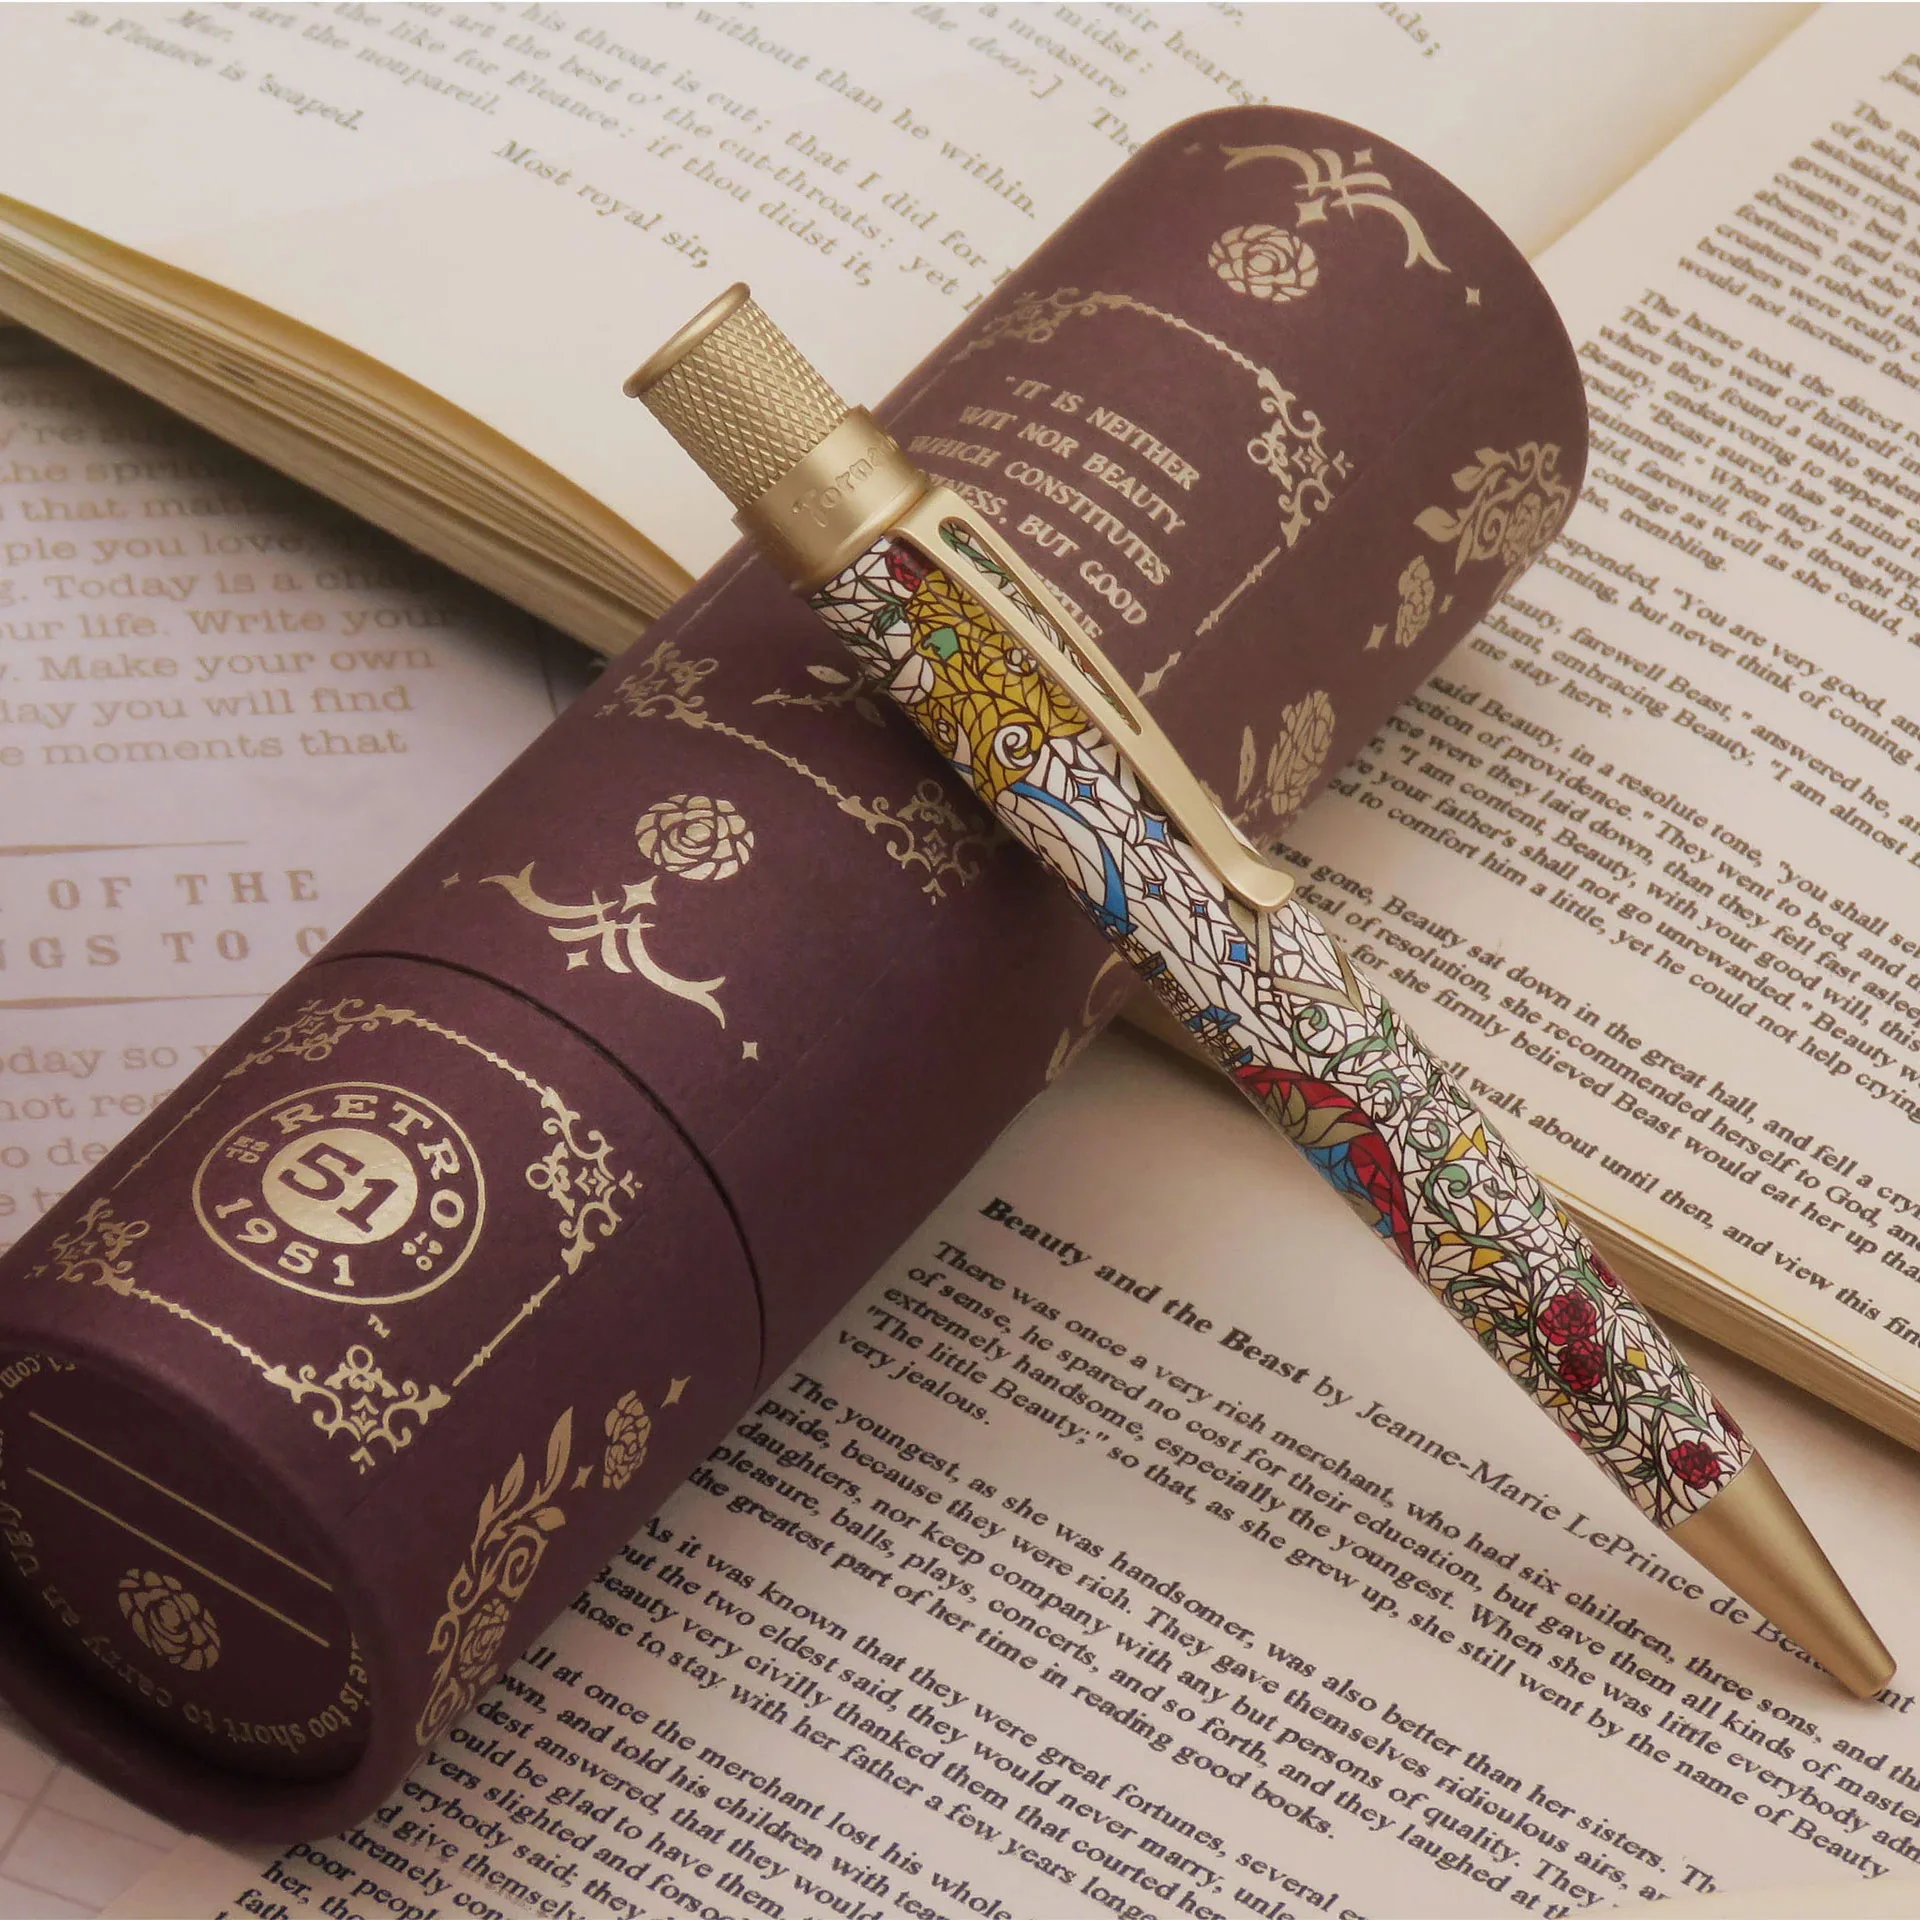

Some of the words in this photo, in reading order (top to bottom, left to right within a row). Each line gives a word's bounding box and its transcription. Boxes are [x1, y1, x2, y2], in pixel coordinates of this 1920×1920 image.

[573, 26, 668, 76] throat
[670, 68, 701, 93] is
[783, 129, 851, 175] that
[880, 191, 939, 232] did
[937, 229, 988, 269] for
[694, 9, 810, 71] without
[814, 67, 884, 114] than
[890, 106, 931, 140] he
[939, 140, 1035, 220] within.
[490, 139, 573, 186] Most
[575, 183, 663, 232] royal
[660, 231, 709, 269] sir,
[557, 54, 623, 93] best
[661, 105, 714, 138] the
[897, 254, 959, 296] yet
[643, 135, 683, 159] if
[681, 156, 752, 203] thou
[757, 200, 838, 255] didst
[840, 250, 872, 287] it,
[959, 405, 1018, 431] WIT
[1017, 421, 1080, 458] NOR
[1082, 451, 1186, 535] BEAUTY
[1050, 391, 1084, 413] IS
[1086, 406, 1200, 490] NEITHER
[907, 435, 1001, 468] WHICH
[1004, 461, 1171, 585] CONSTITUTES
[1591, 467, 1679, 515] courage
[1679, 511, 1707, 530] as
[1711, 525, 1763, 557] well
[1761, 553, 1789, 572] as
[1790, 568, 1832, 594] she
[1833, 592, 1903, 637] could,
[42, 572, 199, 602] Today
[213, 569, 256, 594] is
[271, 572, 303, 593] a
[1017, 513, 1080, 558] BUT
[1079, 560, 1147, 624] GOOD
[36, 652, 179, 681] Make
[193, 650, 317, 683] your
[329, 649, 438, 672] own
[77, 611, 170, 639] life.
[184, 608, 326, 635] Write
[40, 732, 284, 765] moments
[297, 728, 410, 757] that
[91, 697, 189, 728] you
[201, 688, 296, 718] will
[309, 683, 416, 713] find
[46, 875, 132, 911] OF
[173, 868, 319, 906] THE
[1386, 807, 1480, 859] comfort
[1477, 850, 1528, 887] him
[1530, 880, 1547, 897] a
[1547, 888, 1606, 935] little,
[1608, 928, 1654, 957] yet
[1652, 948, 1686, 975] he
[1687, 973, 1759, 1018] could
[1754, 1014, 1798, 1044] not
[1796, 1034, 1853, 1076] help
[159, 928, 252, 964] TO
[1379, 902, 1467, 949] Beauty
[1465, 944, 1506, 970] sat
[1505, 966, 1572, 1010] down
[1571, 1001, 1601, 1028] in
[1602, 1021, 1642, 1050] the
[1639, 1048, 1707, 1088] great
[1705, 1080, 1758, 1124] hall,
[1761, 1119, 1814, 1151] and
[1809, 1143, 1859, 1177] fell
[1855, 1173, 1873, 1188] a
[271, 1094, 465, 1229] RETRO
[277, 1142, 399, 1234] 51
[1469, 1077, 1527, 1119] walk
[1527, 1114, 1599, 1159] about
[1599, 1153, 1660, 1194] until
[1658, 1188, 1714, 1230] then,
[1721, 1225, 1774, 1256] and
[1774, 1250, 1834, 1290] view
[1834, 1287, 1881, 1321] this
[214, 1197, 355, 1287] 1951
[838, 1329, 896, 1369] very
[886, 1360, 990, 1425] jealous.
[977, 1197, 1092, 1267] Beauty
[1093, 1264, 1163, 1304] and
[1160, 1298, 1213, 1334] the
[1216, 1325, 1307, 1384] Beast
[1313, 1373, 1354, 1407] by
[1354, 1401, 1561, 1521] Jeanne-Marie
[1708, 1596, 1749, 1624] de
[933, 1240, 1006, 1291] There
[1011, 1286, 1061, 1321] was
[1063, 1319, 1127, 1357] once
[1128, 1354, 1148, 1370] a
[1154, 1364, 1213, 1403] very
[1211, 1399, 1266, 1434] rich
[1280, 1430, 1394, 1508] merchant,
[1406, 1501, 1461, 1540] who
[1462, 1531, 1520, 1570] had
[1517, 1566, 1562, 1595] six
[1564, 1591, 1675, 1664] children,
[1683, 1656, 1753, 1701] three
[1755, 1698, 1822, 1744] sons,
[1831, 1738, 1889, 1771] and
[340, 1682, 370, 1712] is
[687, 1466, 729, 1496] the
[725, 1494, 835, 1556] greatest
[829, 1552, 893, 1588] part
[892, 1584, 934, 1606] of
[925, 1597, 976, 1633] her
[974, 1626, 1038, 1670] time
[1038, 1661, 1068, 1689] in
[1069, 1684, 1174, 1752] reading
[1170, 1745, 1252, 1789] good
[1250, 1779, 1334, 1840] books.
[183, 1703, 217, 1735] to
[223, 1718, 306, 1754] short
[308, 1705, 351, 1739] too
[675, 1534, 702, 1559] it
[705, 1553, 756, 1589] was
[756, 1579, 848, 1641] known
[851, 1634, 907, 1672] that
[907, 1665, 970, 1708] they
[973, 1702, 1038, 1748] were
[1035, 1746, 1112, 1790] great
[1110, 1782, 1226, 1858] fortunes,
[1234, 1852, 1339, 1912] several
[261, 1860, 312, 1904] her,
[284, 1843, 356, 1881] poor
